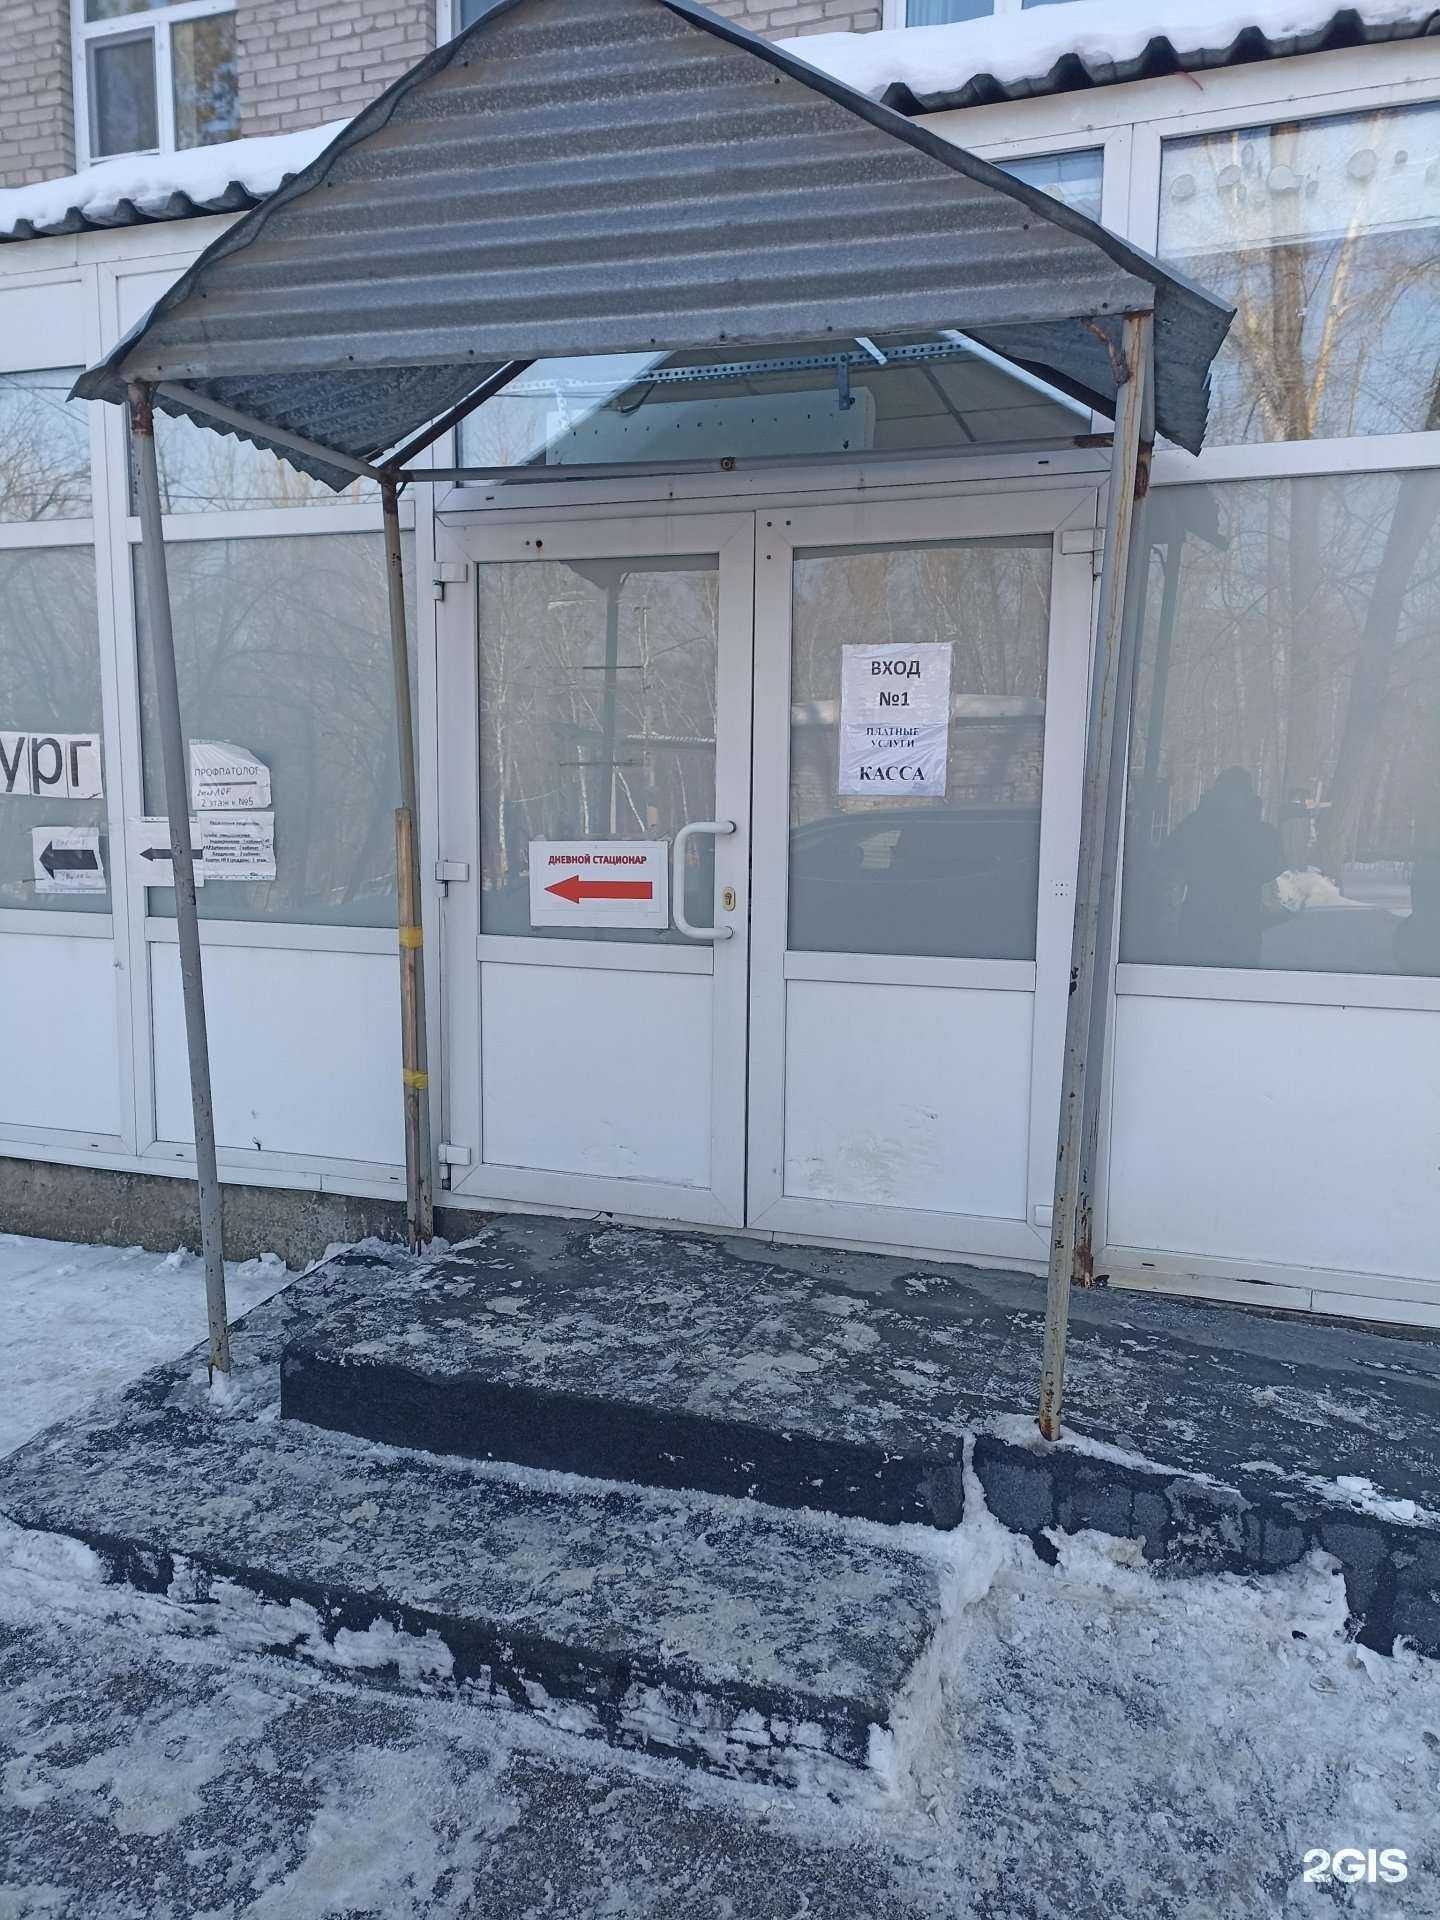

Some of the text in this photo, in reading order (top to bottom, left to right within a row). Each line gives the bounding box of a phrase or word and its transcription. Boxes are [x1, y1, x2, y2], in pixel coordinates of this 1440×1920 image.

[871, 660, 921, 678] ВХОД
[879, 691, 910, 706] №1
[866, 727, 920, 736] ПЛАТНЫЕ
[871, 739, 915, 748] УСЛУГИ
[194, 766, 259, 777] ПРОФПАТОЛОГ
[859, 766, 925, 781] КАССА
[201, 798, 207, 808] 2
[238, 796, 254, 807] №5
[548, 853, 648, 866] ДНЕВНОЙ СТАЦИОНАР
